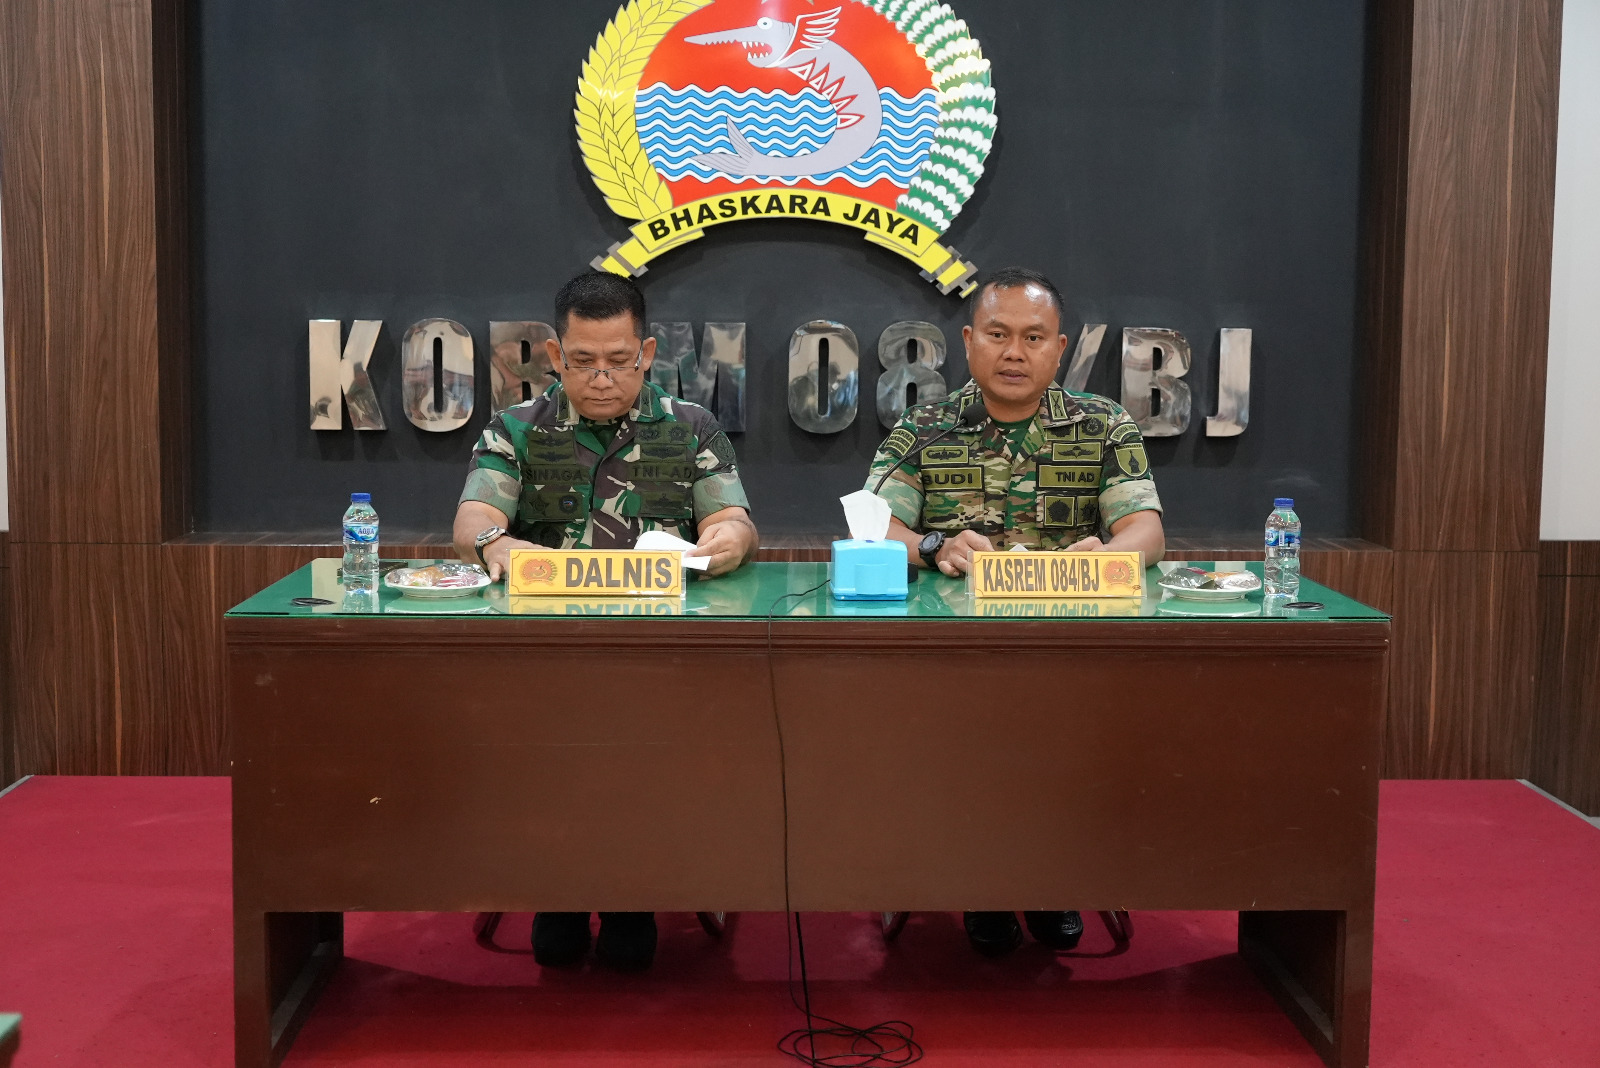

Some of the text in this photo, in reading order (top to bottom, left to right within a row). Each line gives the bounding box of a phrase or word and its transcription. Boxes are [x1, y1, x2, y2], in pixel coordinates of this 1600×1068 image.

[648, 194, 920, 246] BHASKARA JAYA
[308, 317, 1252, 438] KORM 08/BJ
[526, 468, 583, 481] SINAGA
[632, 465, 693, 479] TNI AD
[922, 473, 973, 485] BUDI
[1055, 471, 1095, 482] TNI AD
[565, 557, 672, 588] DALNIS
[982, 557, 1100, 592] KASREM 084/BJ
